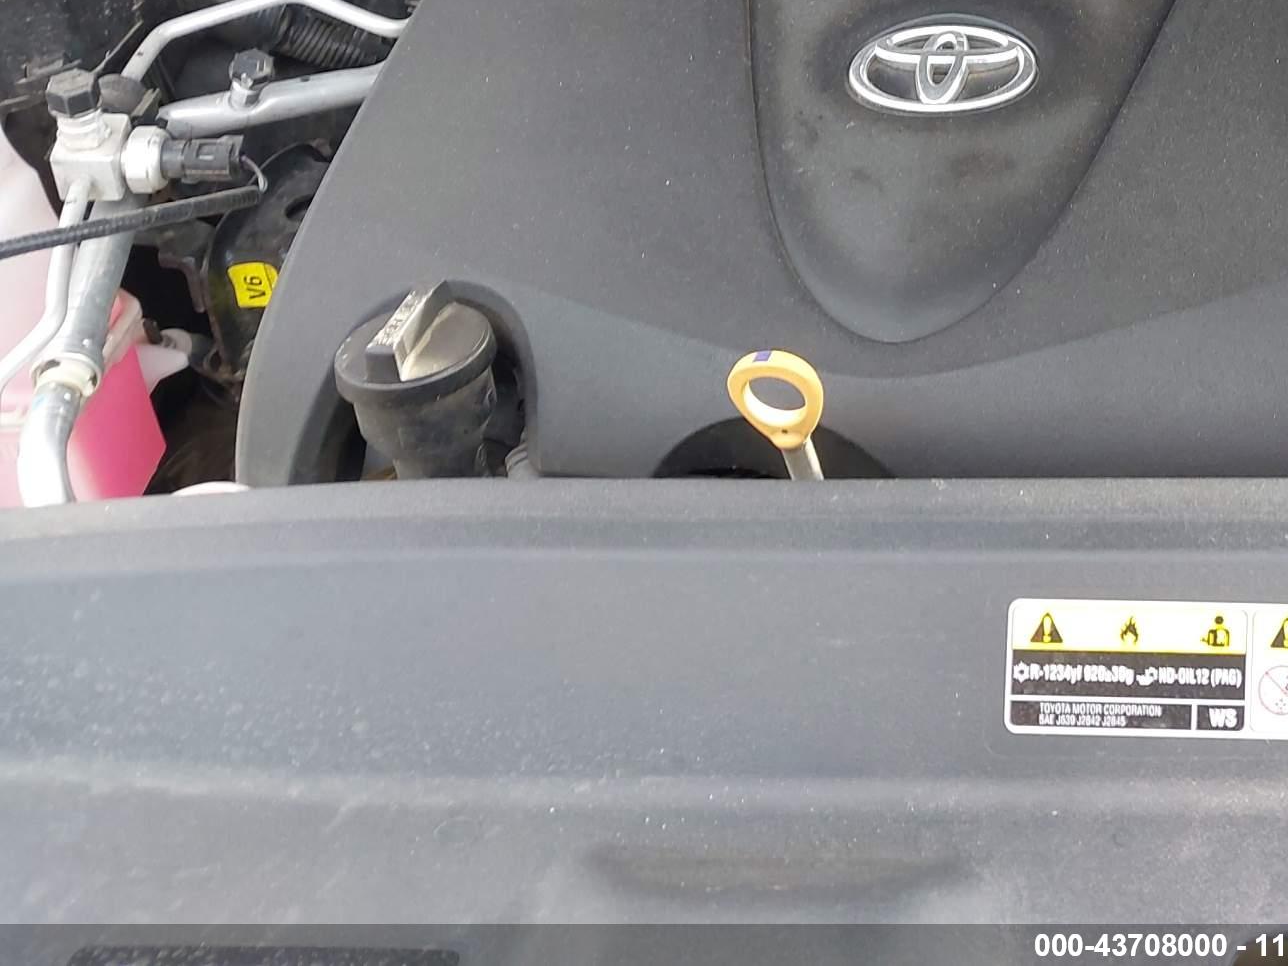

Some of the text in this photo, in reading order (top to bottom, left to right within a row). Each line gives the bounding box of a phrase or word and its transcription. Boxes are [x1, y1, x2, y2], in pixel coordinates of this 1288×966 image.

[243, 275, 266, 300] V6
[1210, 667, 1243, 689] (PAG)
[1040, 702, 1163, 717] TOYOTA MOTOR CORPORATION
[1208, 707, 1238, 728] WS
